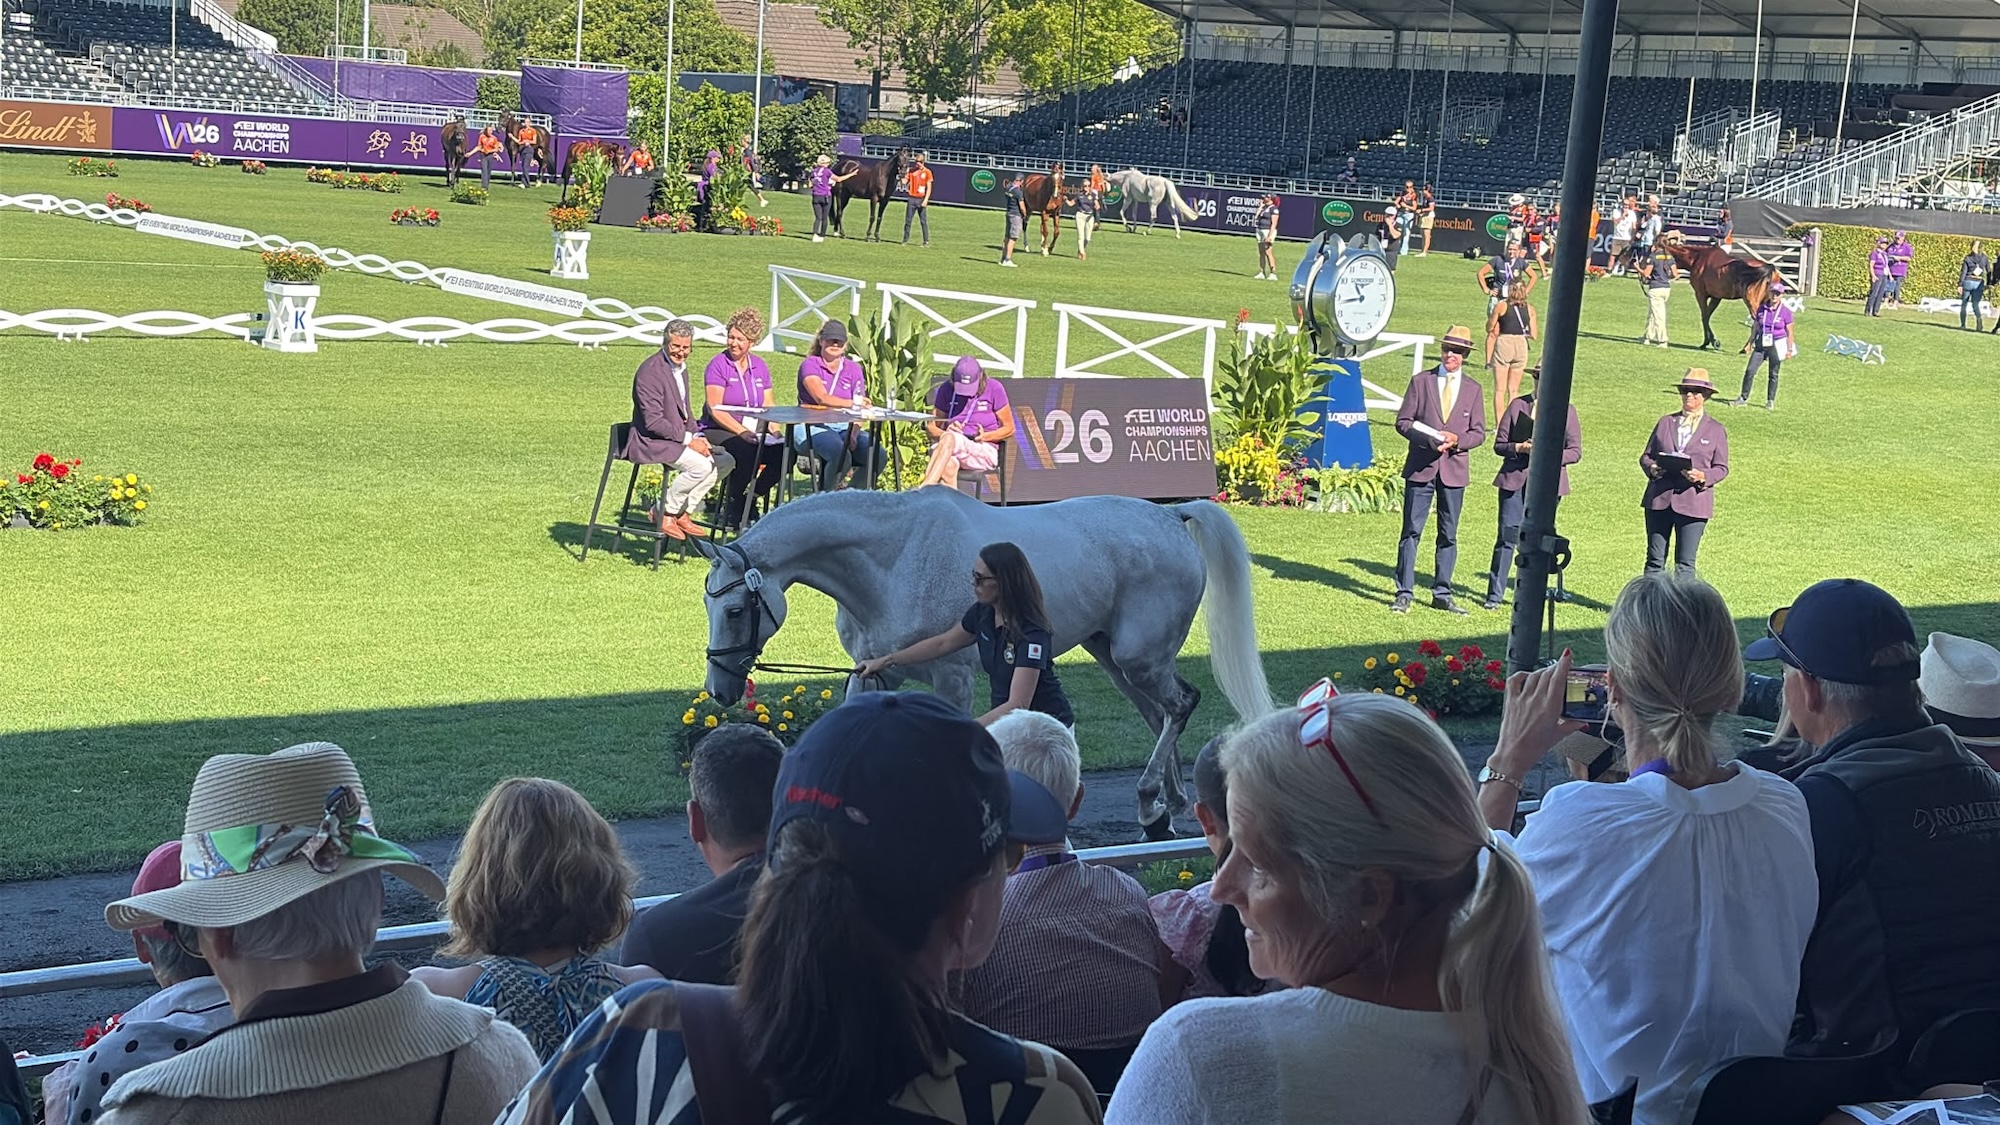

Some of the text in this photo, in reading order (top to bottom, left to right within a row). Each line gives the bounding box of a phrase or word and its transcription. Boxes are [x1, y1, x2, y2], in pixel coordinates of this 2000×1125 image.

[0, 110, 77, 142] Lindt
[256, 122, 290, 132] WORLD
[233, 138, 290, 154] AACHEN
[484, 282, 504, 293] WORLD
[504, 286, 545, 302] CHAMPIONSHIP
[545, 292, 568, 307] AACHEN
[567, 299, 583, 309] 2026
[294, 310, 306, 330] K
[1124, 408, 1206, 424] FEI WORLD
[1125, 425, 1208, 437] CHAMPIONSHIPS
[1129, 439, 1211, 462] AACHEN
